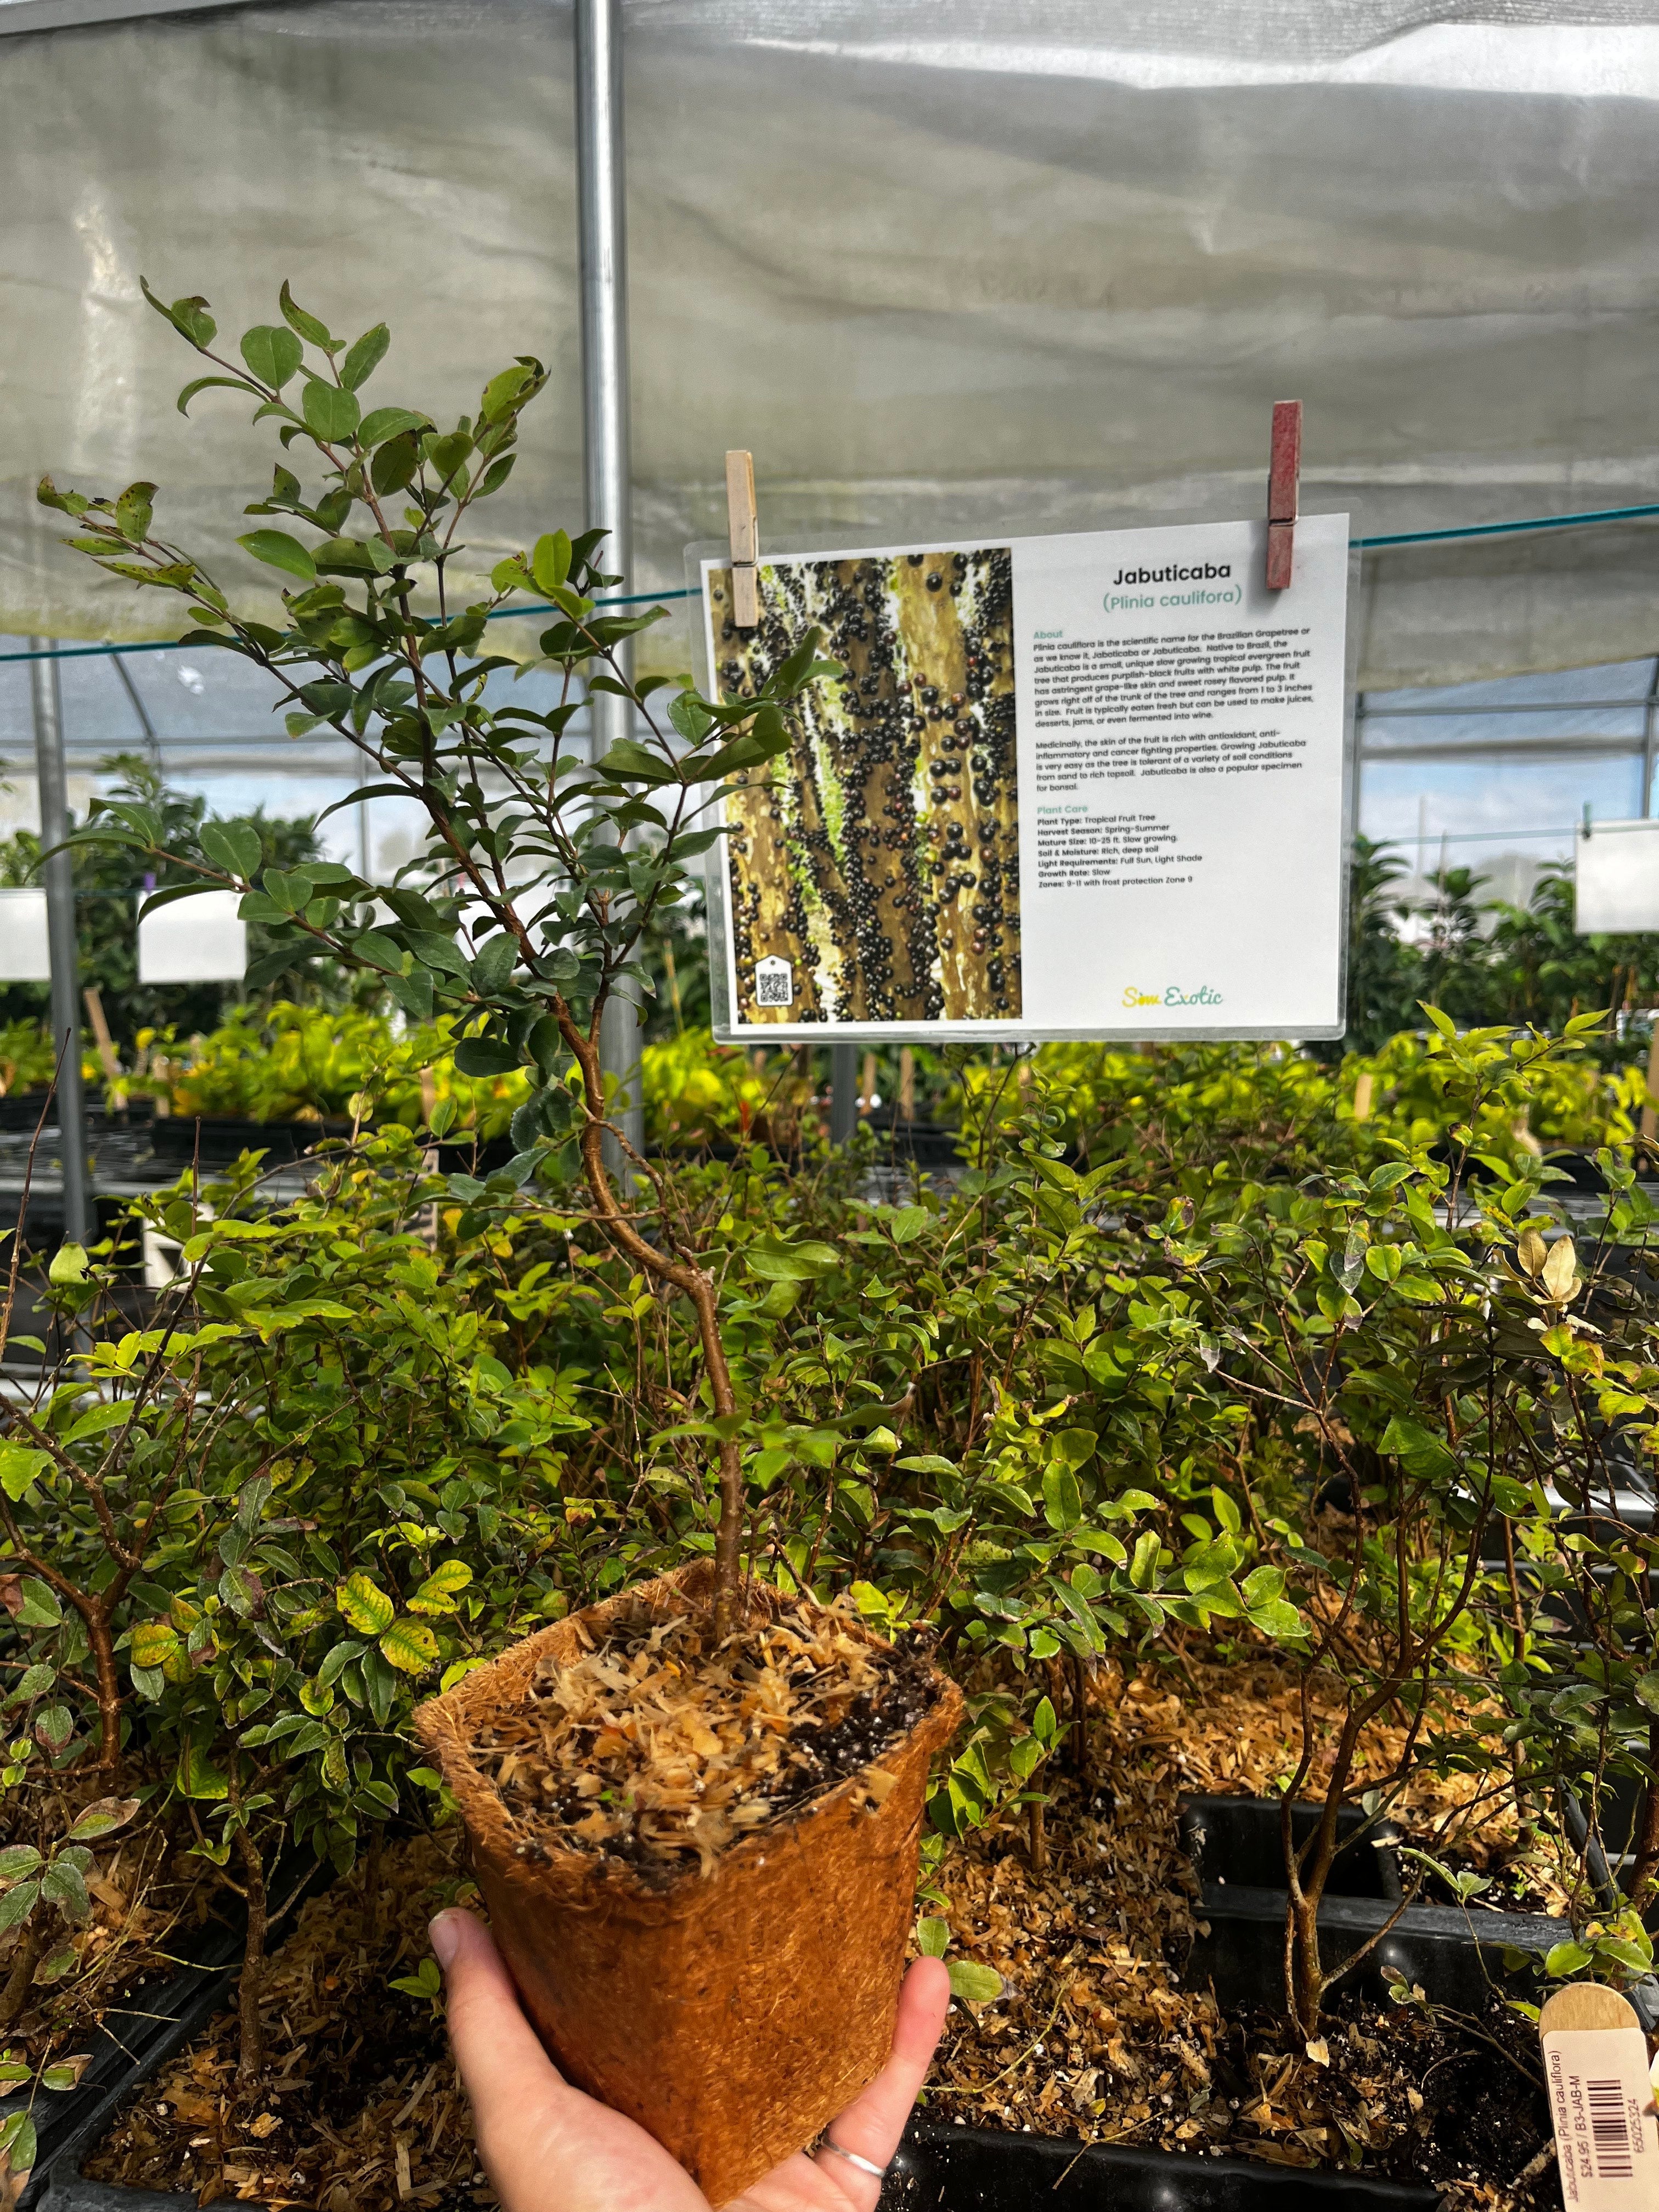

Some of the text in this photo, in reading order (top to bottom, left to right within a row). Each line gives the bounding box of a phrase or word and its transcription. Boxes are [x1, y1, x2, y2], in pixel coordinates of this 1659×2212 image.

[1113, 563, 1232, 585] Jabuticaba
[1103, 584, 1243, 613] (Plinia caulifora)
[1033, 643, 1056, 652] Plinia
[1106, 639, 1120, 647] the
[1121, 636, 1159, 646] scientific
[1187, 634, 1200, 642] for
[1201, 633, 1216, 641] the
[1217, 630, 1254, 640] Brazilian
[1255, 628, 1299, 639] Grapetree
[1034, 630, 1063, 640] About
[1206, 643, 1234, 652] Native
[1273, 639, 1288, 648] the
[1034, 649, 1311, 674] Jabuticaba small, unique slow growing tropical evergreen fruit
[1052, 675, 1069, 684] that
[1070, 673, 1110, 684] produces
[1111, 668, 1172, 682] purplish-black
[1173, 667, 1195, 676] fruits
[1197, 666, 1215, 675] with
[1217, 665, 1240, 674] white
[1265, 663, 1282, 671] The
[1283, 661, 1301, 670] fruit
[1051, 685, 1093, 695] astringent
[1094, 682, 1138, 694] grape-like
[1139, 681, 1157, 690] skin
[1158, 679, 1176, 689] and
[1177, 678, 1202, 687] sweet
[1204, 678, 1228, 687] rosey
[1228, 674, 1265, 684] flavored
[1034, 699, 1059, 709] grows
[1061, 696, 1080, 707] right
[1081, 695, 1093, 704] off
[1120, 692, 1142, 702] trunk
[1154, 691, 1168, 699] the
[1188, 689, 1205, 698] and
[1207, 689, 1237, 698] ranges
[1238, 686, 1259, 695] from
[1284, 684, 1313, 692] inches
[1065, 706, 1084, 715] Fruit
[1094, 704, 1130, 716] typically
[1130, 704, 1155, 712] eaten
[1156, 702, 1177, 710] fresh
[1179, 701, 1194, 709] but
[1227, 697, 1248, 707] used
[1260, 696, 1285, 704] make
[1286, 695, 1313, 706] juices,
[1035, 719, 1071, 728] desserts,
[1072, 718, 1094, 728] jams,
[1128, 713, 1172, 723] fermented
[1035, 729, 1280, 749] Medicinally, the skin the fruit rich with antioxidant, anti-
[1036, 751, 1091, 760] inflammatory
[1092, 749, 1109, 757] and
[1141, 746, 1173, 757] fighting
[1220, 742, 1256, 752] Growing
[1257, 739, 1307, 749] Jabuticaba
[1045, 763, 1062, 771] very
[1097, 760, 1111, 768] the
[1139, 755, 1172, 765] tolerant
[1191, 754, 1221, 764] variety
[1232, 752, 1247, 761] soil
[1248, 751, 1293, 760] conditions
[1057, 772, 1077, 781] sand
[1140, 767, 1188, 776] Jabuticaba
[1198, 765, 1216, 774] also
[1226, 763, 1259, 774] popular
[1261, 761, 1302, 772] specimen
[1037, 806, 1062, 814] Plant
[1037, 818, 1058, 826] Plant
[1060, 817, 1082, 827] Type:
[1085, 815, 1116, 825] Tropical
[1118, 814, 1136, 822] Fruit
[1037, 828, 1069, 836] Harvest
[1105, 825, 1170, 835] Spring-Summer
[1038, 849, 1053, 857] Soil
[1062, 848, 1099, 856] Moisture:
[1122, 847, 1143, 855] deep
[1144, 845, 1159, 853] soil
[1038, 860, 1058, 870] Light
[1059, 857, 1118, 868] Requirements:
[1155, 855, 1175, 865] Light
[1176, 854, 1203, 862] Shade
[1038, 870, 1067, 878] Growth
[1122, 877, 1164, 887] protection
[1164, 985, 1223, 1007] Exotic
[1548, 2051, 1565, 2103] cauliflora)
[1568, 2075, 1587, 2131] B3-JAB-M
[1558, 2107, 1573, 2141] (Plinia
